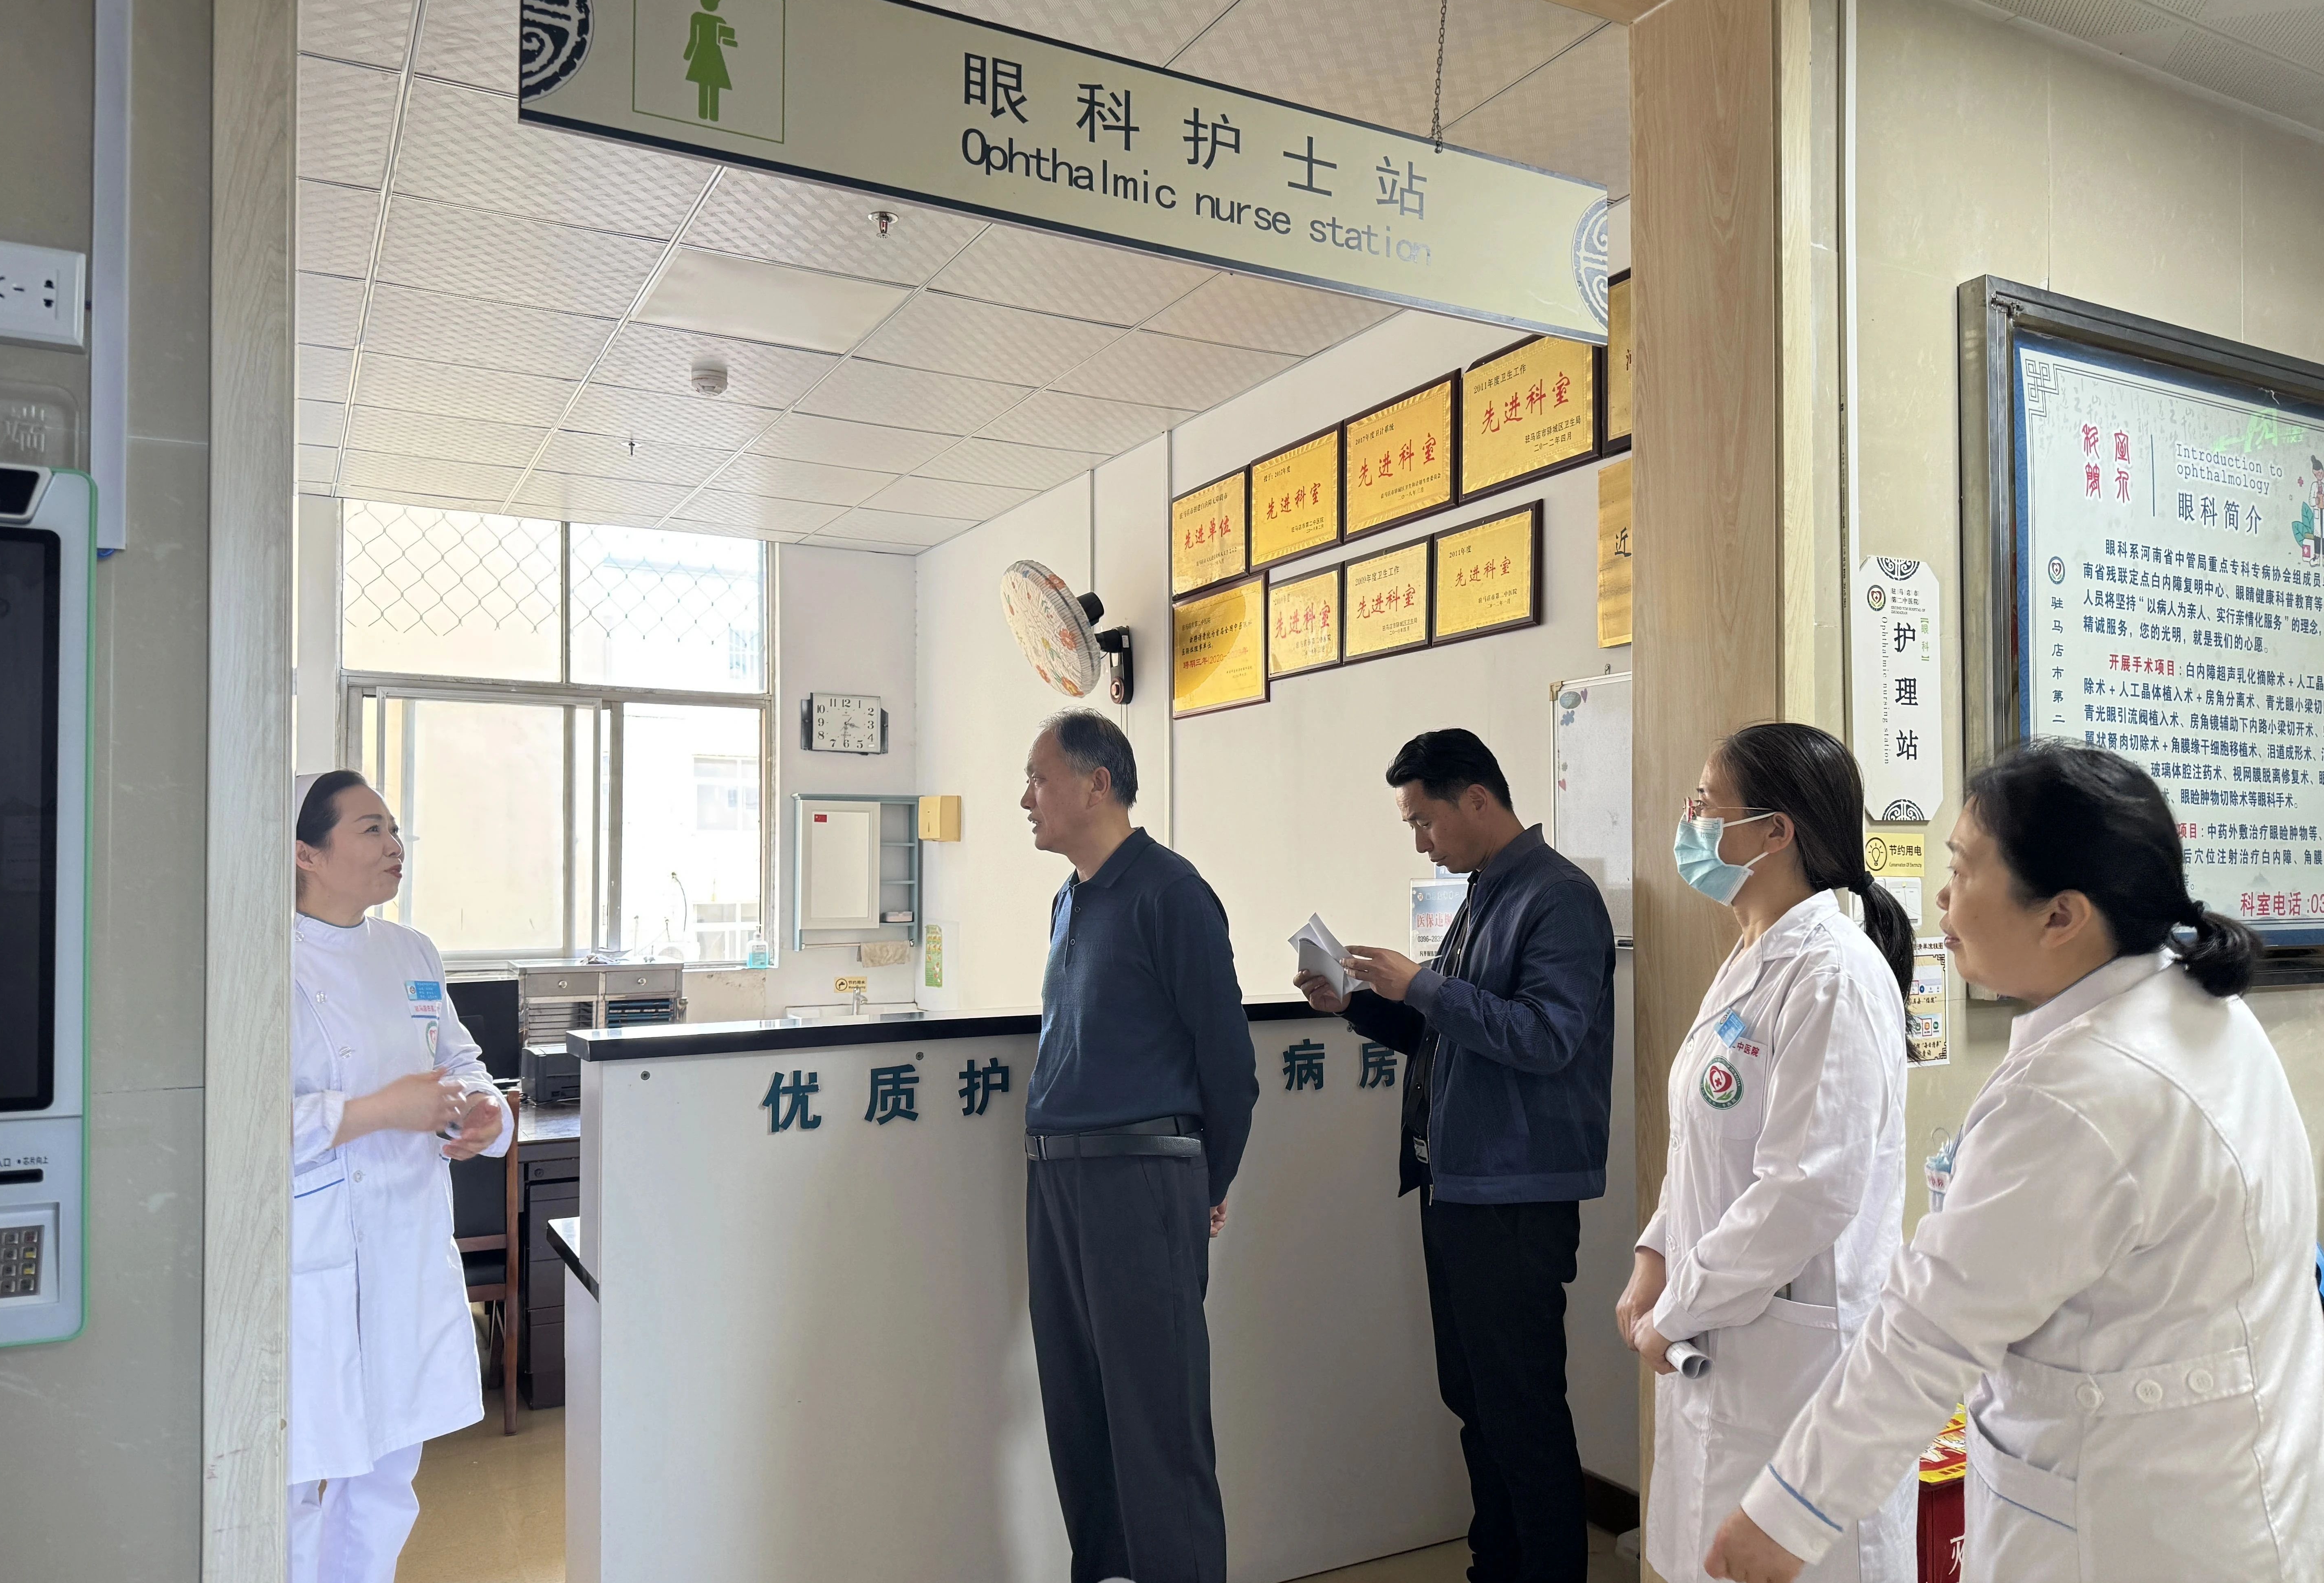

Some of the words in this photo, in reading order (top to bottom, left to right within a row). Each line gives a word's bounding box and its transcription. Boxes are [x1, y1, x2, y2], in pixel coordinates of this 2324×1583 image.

[964, 52, 1427, 220] 眼科护士站
[962, 128, 1176, 209] Ophthalmic
[1195, 192, 1291, 235] nurse
[1309, 216, 1432, 266] station
[1474, 363, 1526, 394] 2011年度卫生工作
[1481, 371, 1571, 434] 先进科室
[1524, 415, 1581, 444] 驻马店市驿城区卫生局
[1358, 432, 1436, 487] 先进科室
[2176, 443, 2262, 474] Introduction
[2270, 463, 2282, 478] to
[2176, 463, 2270, 495] ophthalmology
[1267, 482, 1321, 520] 先进科室
[2178, 492, 2262, 535] 眼科简介
[1184, 515, 1231, 550] 先进单位
[1449, 545, 1471, 558] 2011年度
[2106, 539, 2324, 588] 眼科系河南省中管局重点专科专病协会组成员
[1455, 556, 1511, 587] 先进科室
[1356, 583, 1416, 619] 先进科室
[1891, 588, 1919, 597] 驻马店市
[1891, 596, 1919, 605] 第二中医院
[1275, 599, 1331, 639] 先进科室
[1880, 616, 1889, 678] Ophthalmic
[2051, 596, 2066, 723] 驻马店市第二
[830, 698, 836, 707] 11
[842, 699, 851, 707] 12
[859, 700, 861, 709] 1
[1893, 622, 1919, 761] 护理站
[2084, 677, 2324, 714] 除术+人工晶体植入术+房角分离术、青光眼小梁切
[817, 705, 825, 713] 10
[818, 718, 824, 726] 9
[868, 708, 874, 716] 2
[868, 720, 874, 729] 3
[2084, 704, 2324, 738] 青光眼引流阀植入术、房角镜辅助下内路小梁切开术、
[818, 731, 824, 740] 8
[830, 739, 836, 747] 7
[843, 740, 849, 748] 6
[857, 740, 863, 749] 5
[867, 733, 873, 742] 4
[2085, 731, 2324, 761] 翼状胬肉切除术+角膜缘干细胞移植术、泪道成形术、
[1889, 845, 1922, 856] 节约用电
[763, 1057, 1009, 1133] 优质护
[1282, 1038, 1397, 1091] 病房
